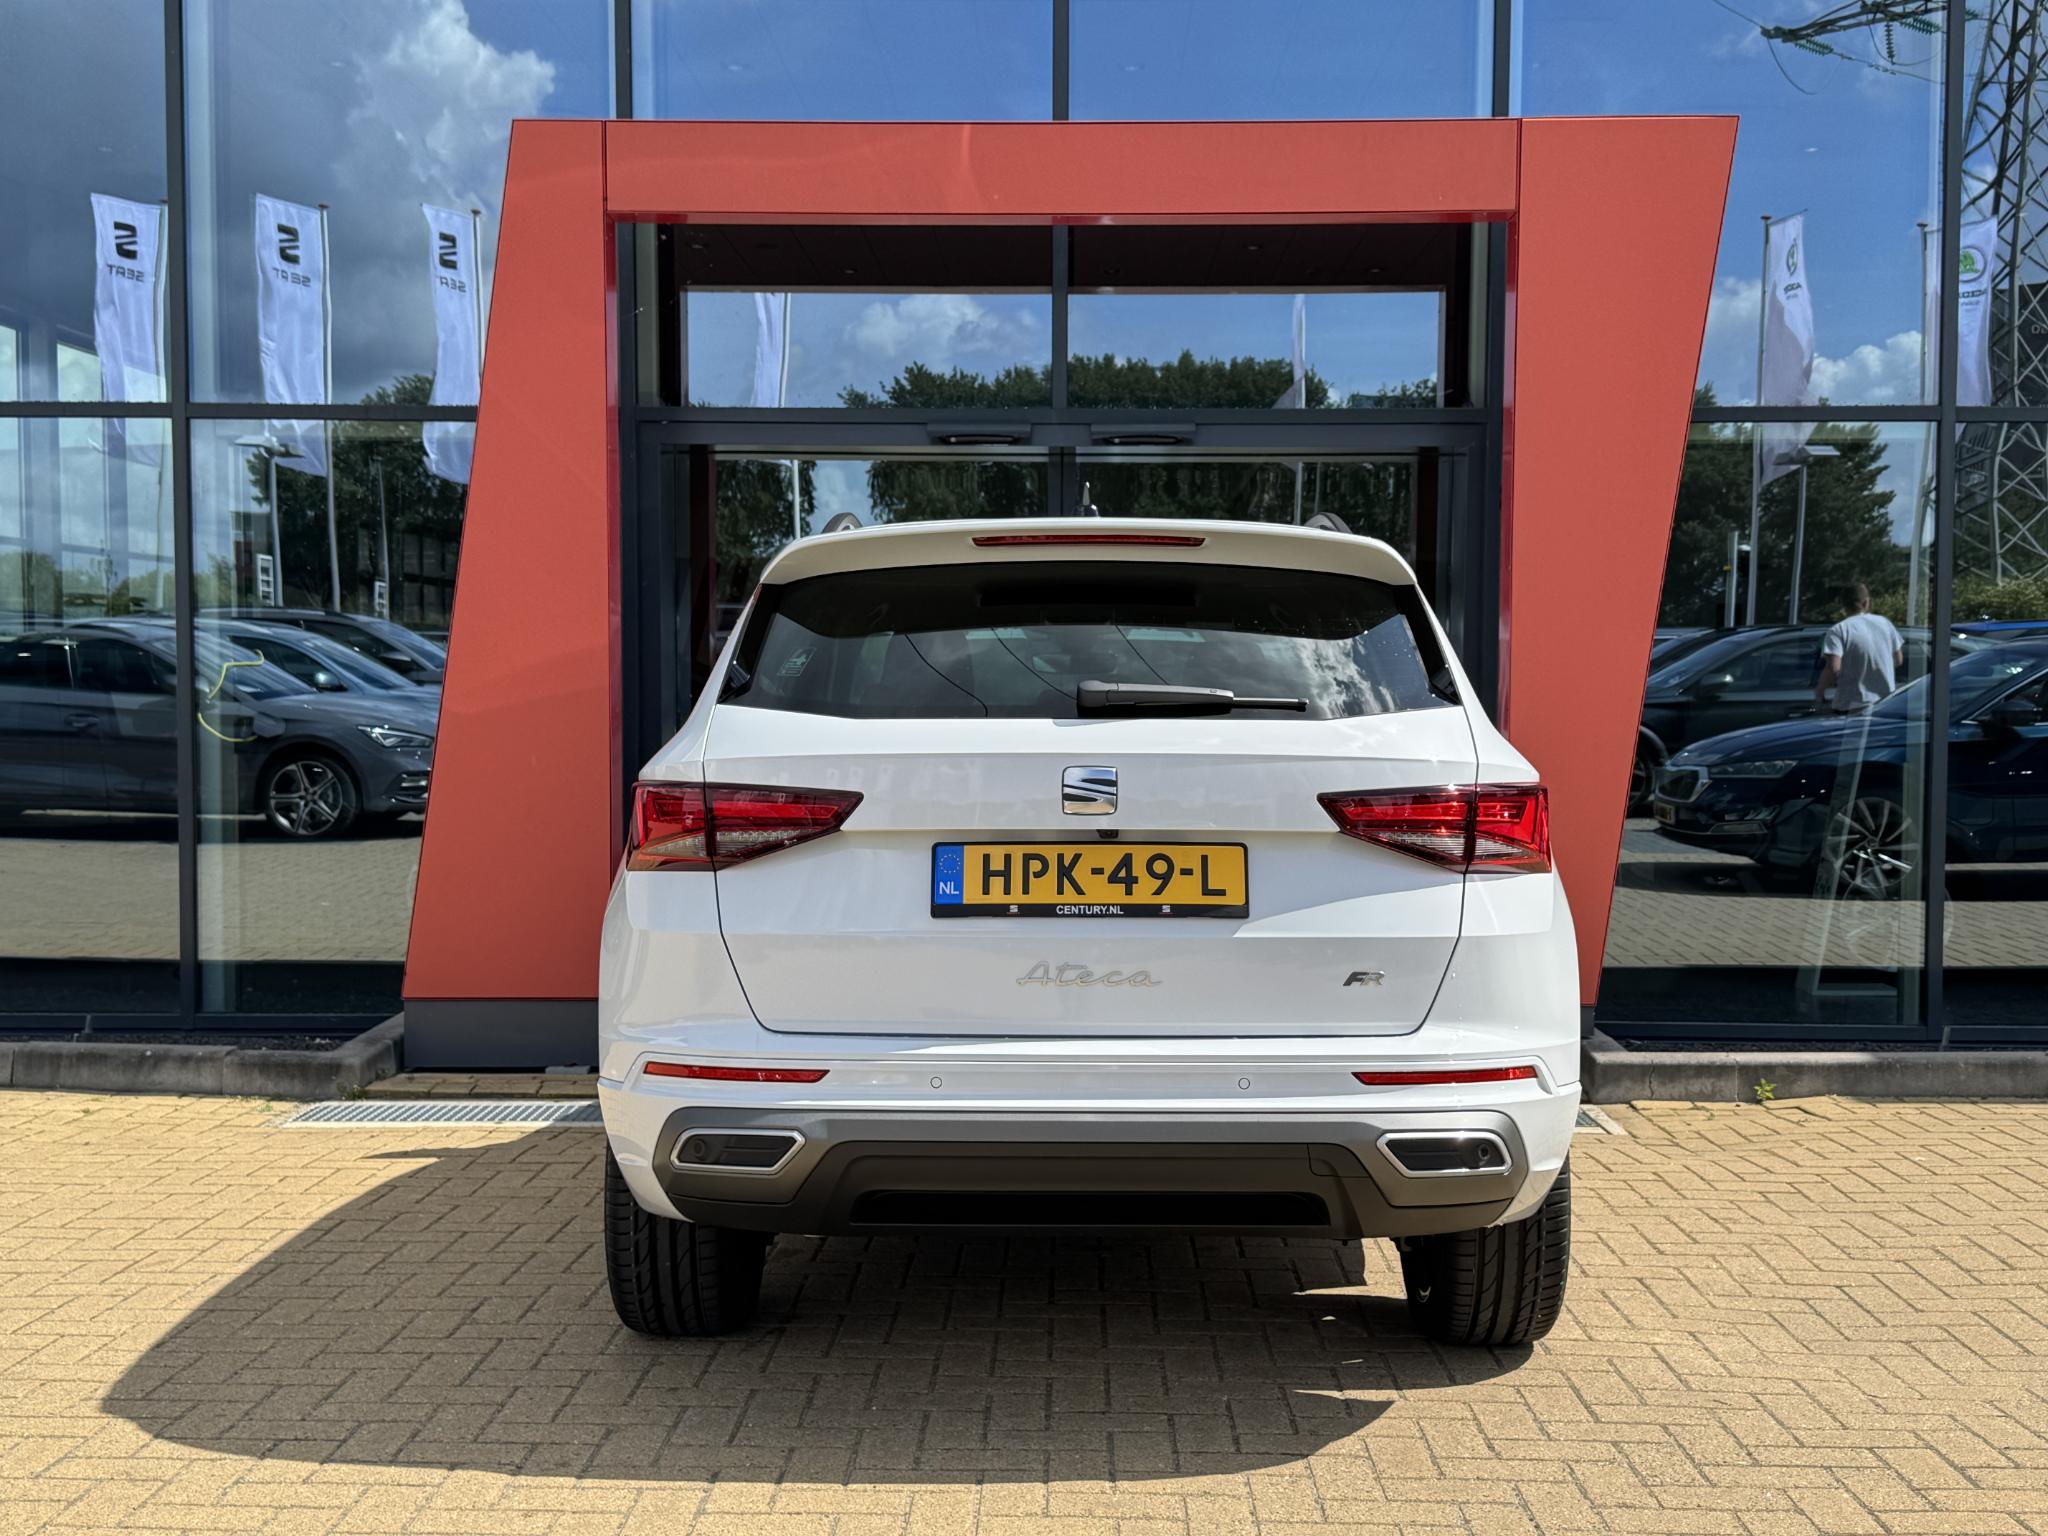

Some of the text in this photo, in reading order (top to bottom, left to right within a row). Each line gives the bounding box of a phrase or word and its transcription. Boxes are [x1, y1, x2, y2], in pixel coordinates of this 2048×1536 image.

[982, 852, 1227, 897] HPK-49-L
[939, 881, 960, 895] NL
[1056, 904, 1125, 915] CENTURY.NL
[1016, 960, 1163, 988] Ateca
[1342, 971, 1385, 987] FR
